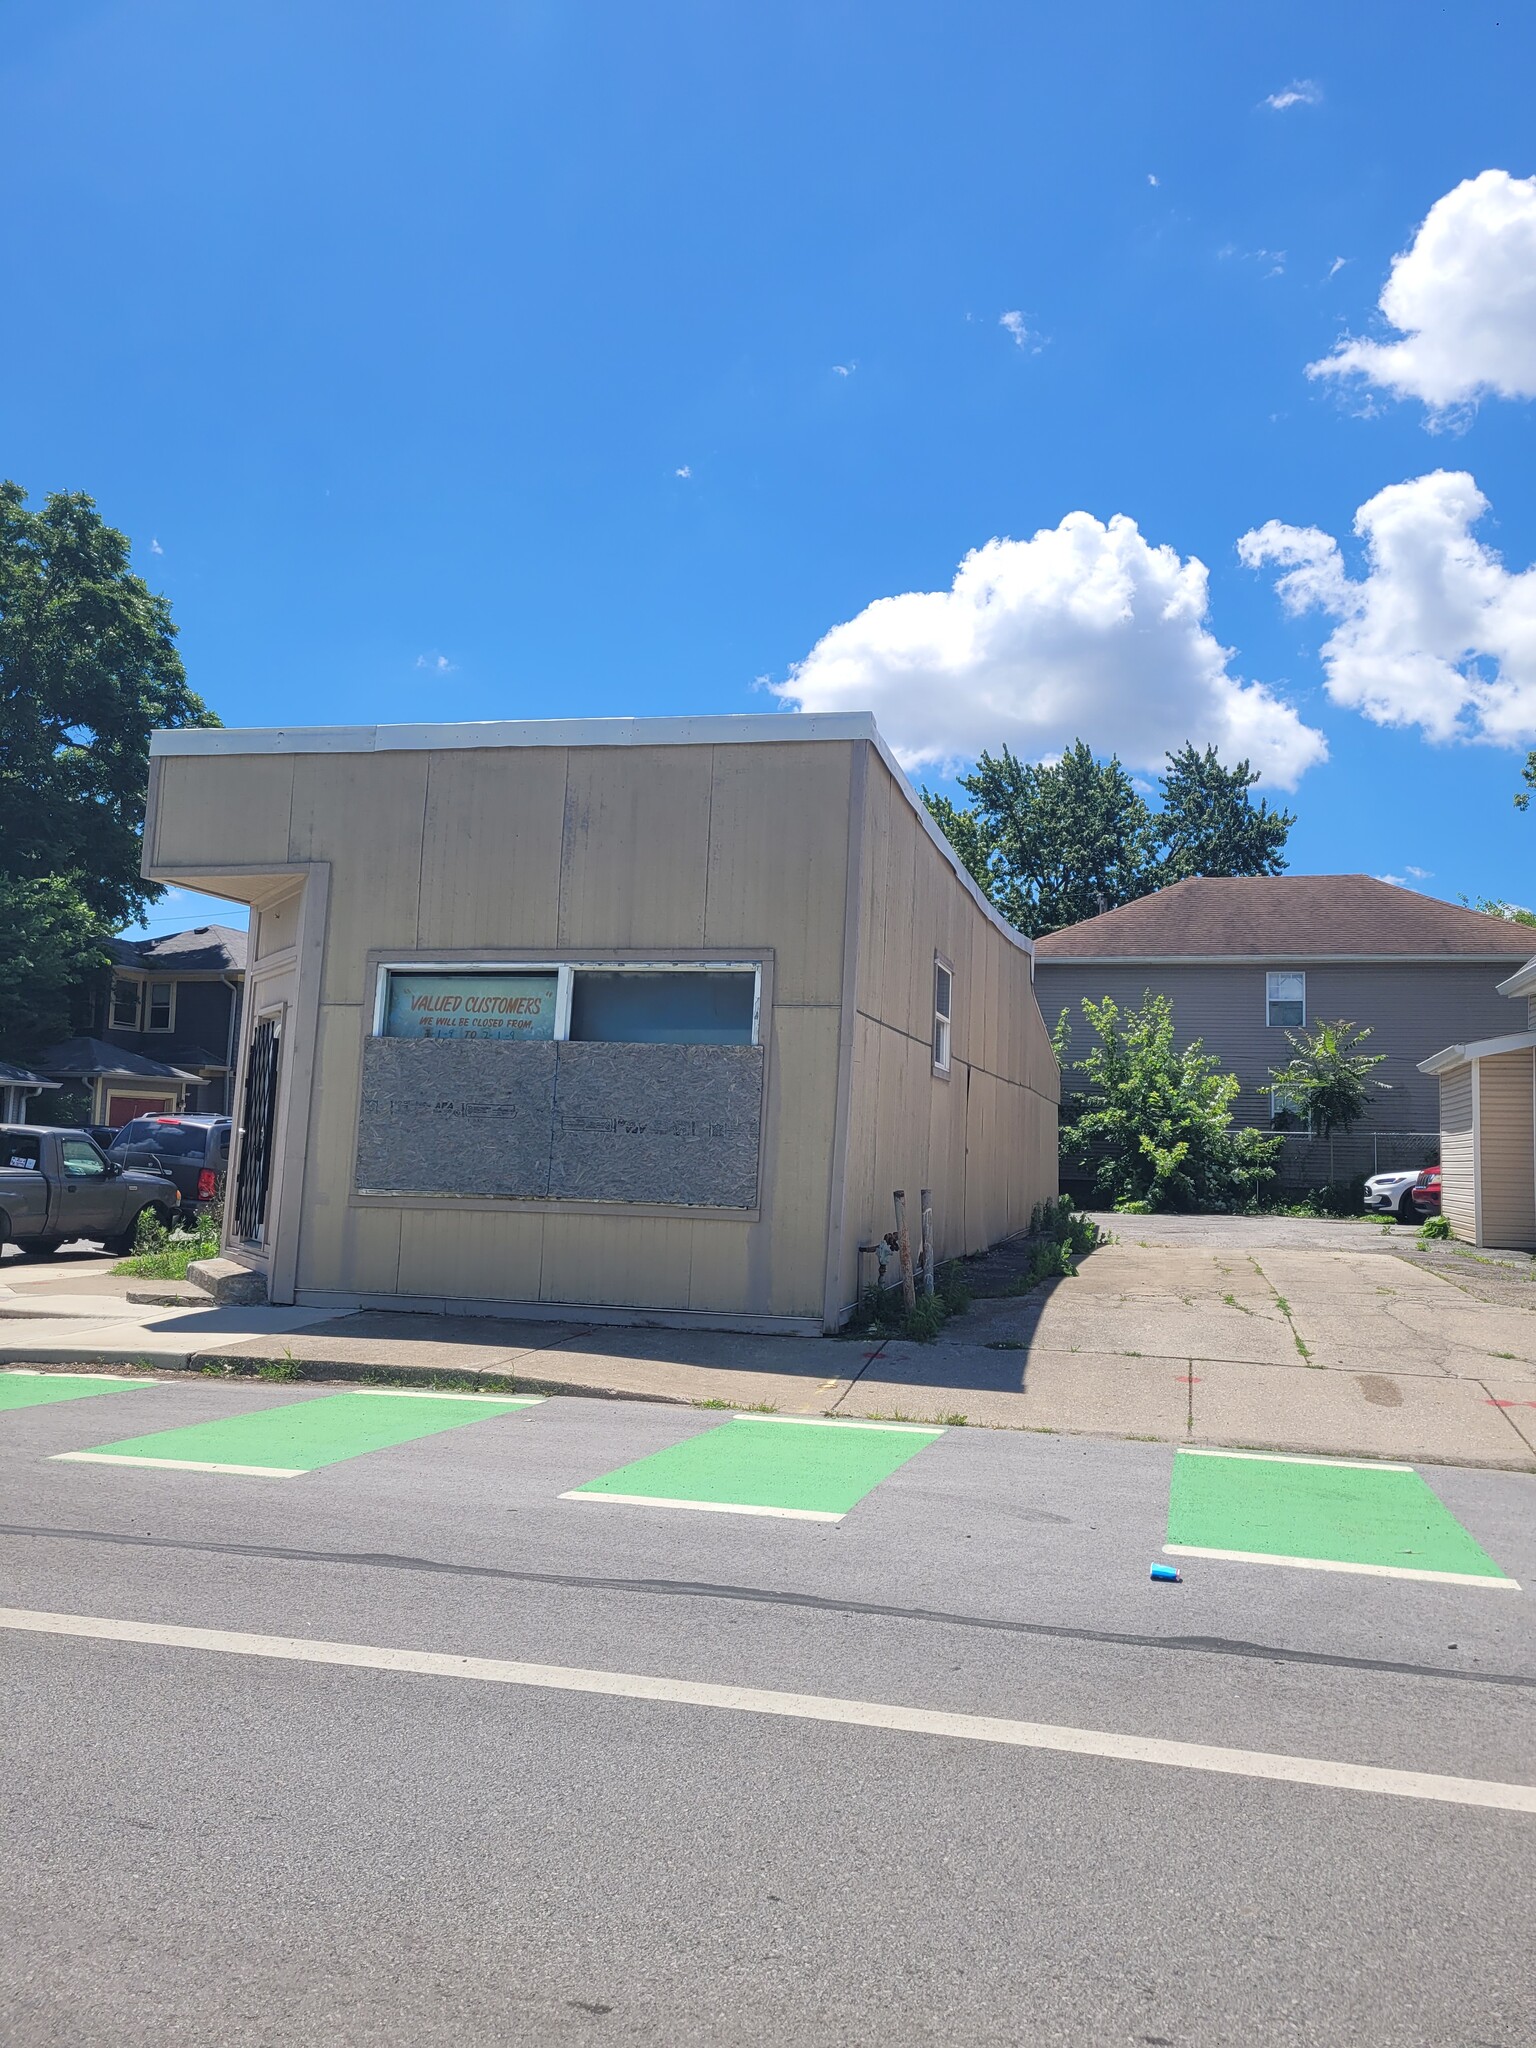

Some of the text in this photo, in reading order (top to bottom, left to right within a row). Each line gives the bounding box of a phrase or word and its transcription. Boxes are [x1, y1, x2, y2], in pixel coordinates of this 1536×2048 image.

[419, 1017, 433, 1026] WE
[436, 1017, 456, 1027] WILL
[459, 1018, 470, 1027] BE
[472, 1018, 503, 1028] CLOSED
[464, 1030, 477, 1039] TO
